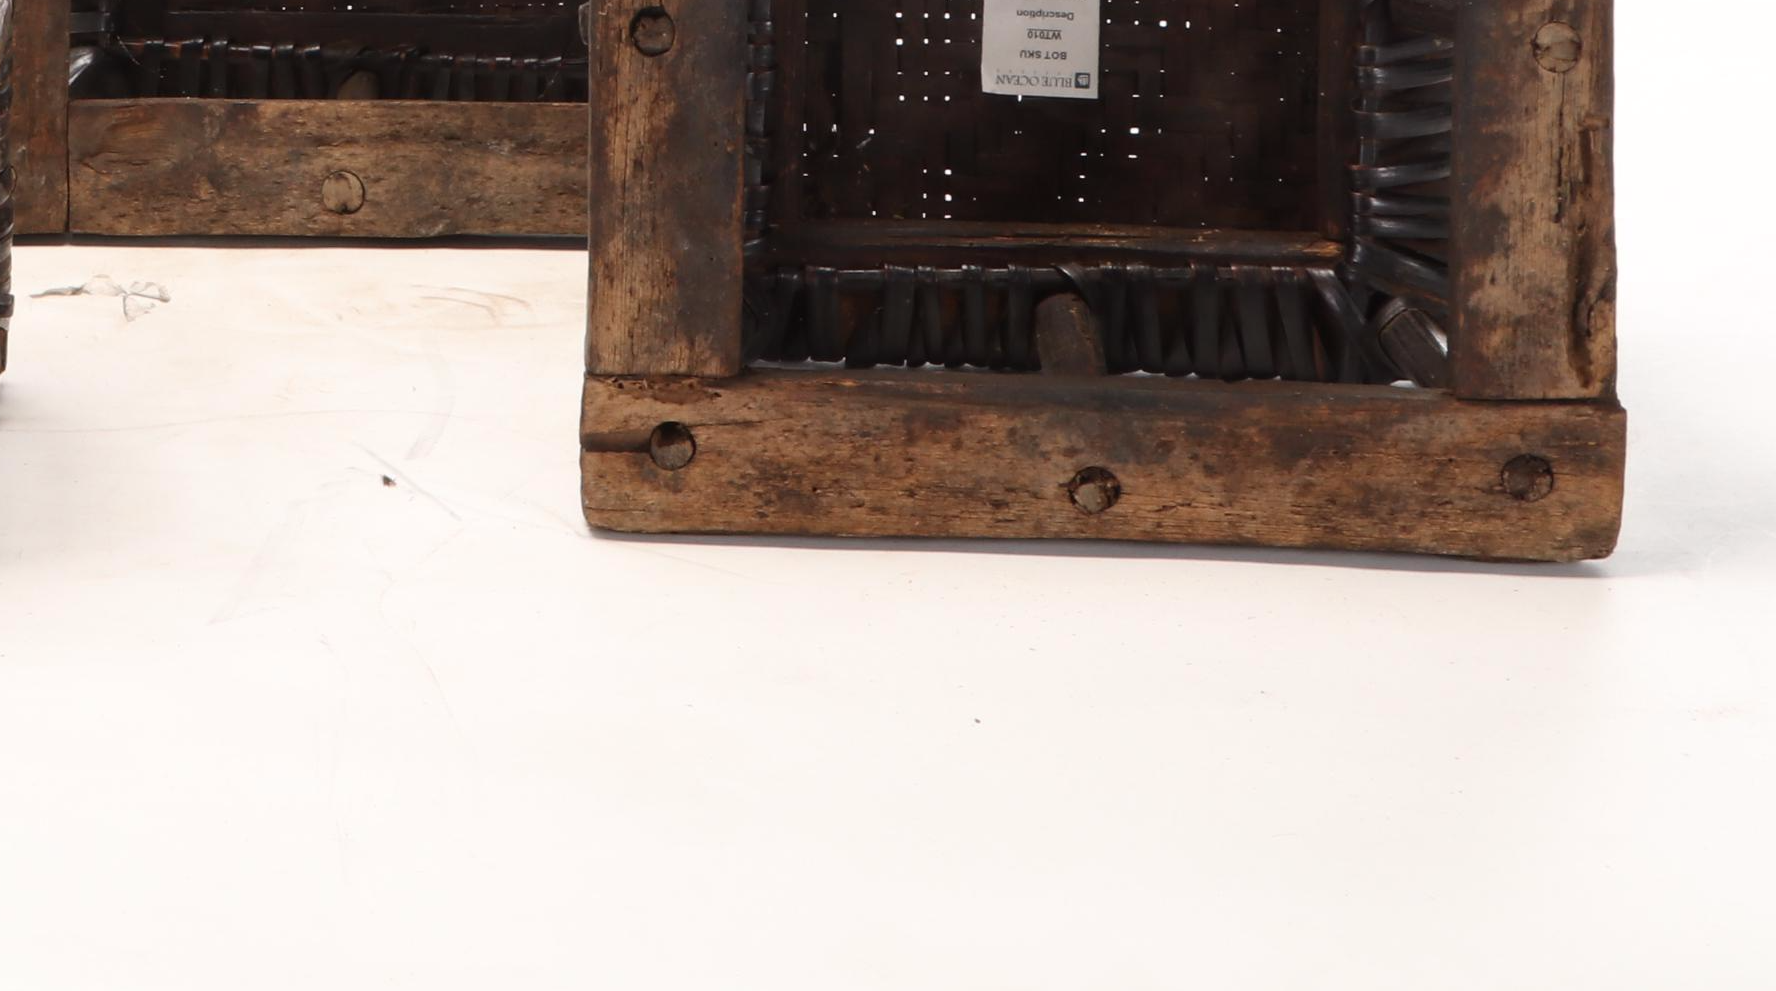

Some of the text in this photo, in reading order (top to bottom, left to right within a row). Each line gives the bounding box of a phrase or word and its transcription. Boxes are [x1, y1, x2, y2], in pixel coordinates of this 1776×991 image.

[1017, 9, 1074, 20] Description
[1027, 29, 1061, 40] WT010
[1020, 50, 1067, 60] BOT SKU
[995, 75, 1072, 88] BLUE OCEAN
